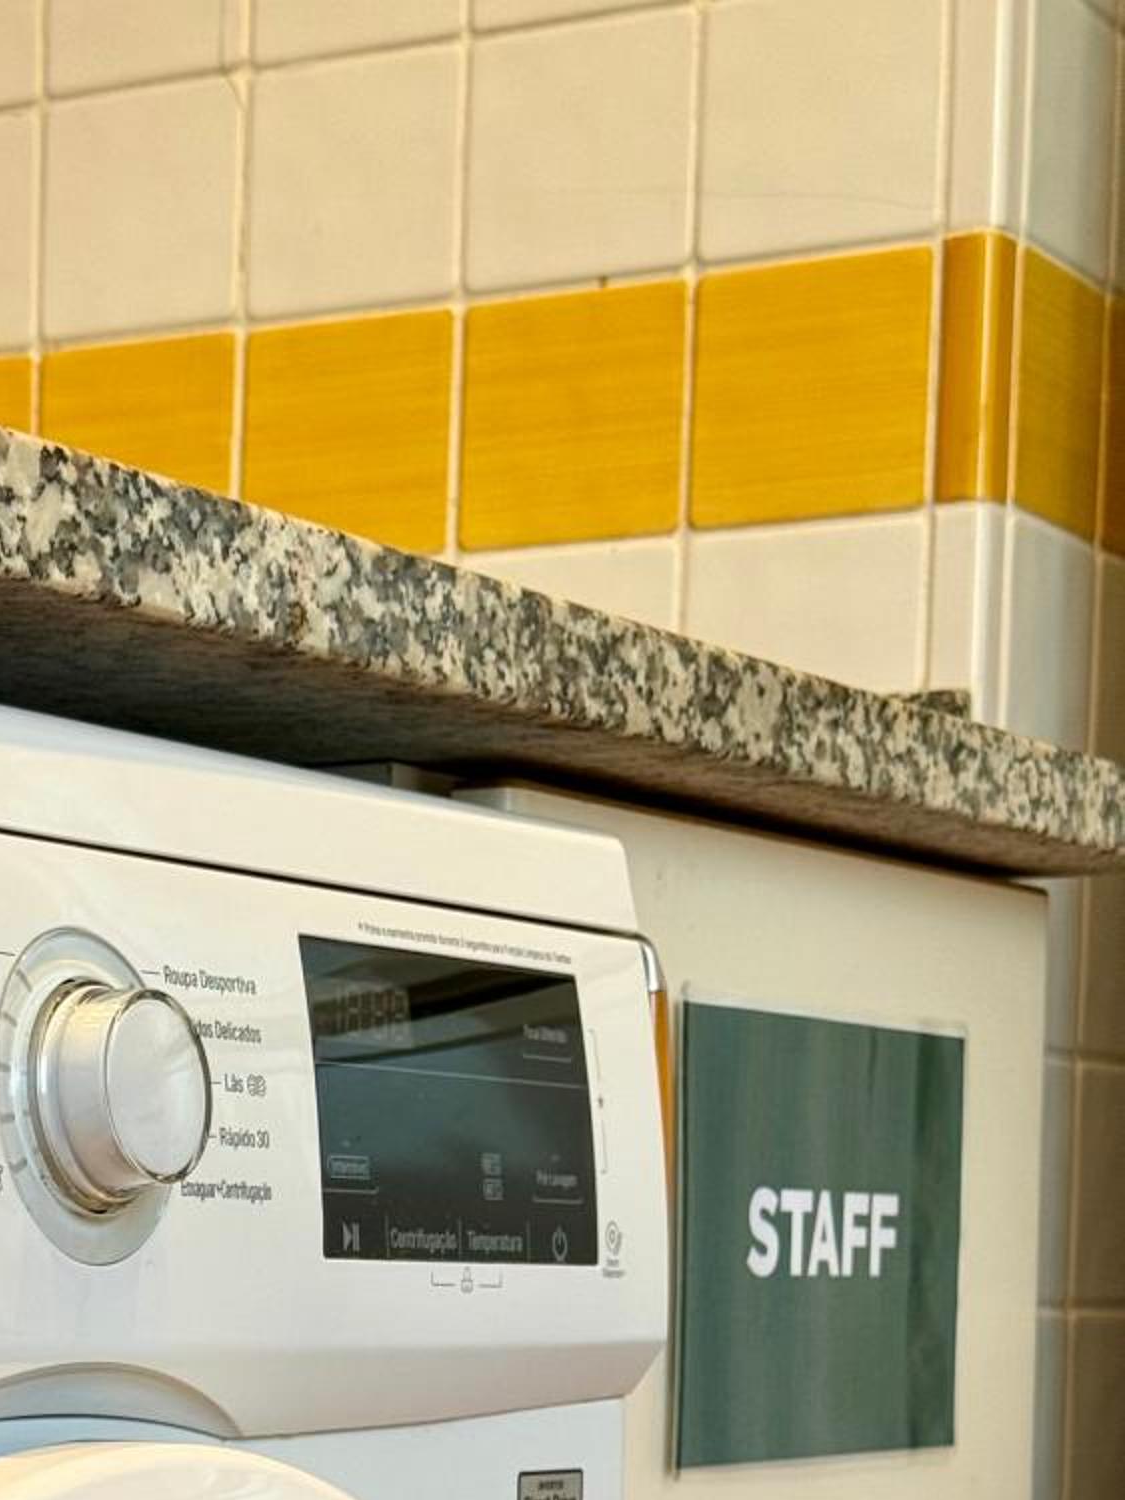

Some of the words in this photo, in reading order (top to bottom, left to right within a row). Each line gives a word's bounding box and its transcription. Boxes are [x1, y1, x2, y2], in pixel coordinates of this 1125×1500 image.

[163, 965, 198, 989] Roupa
[199, 969, 256, 996] Desportiva
[215, 1021, 262, 1043] Delicados
[220, 1127, 255, 1150] Rápido
[256, 1130, 270, 1149] 30
[747, 1187, 899, 1278] STAFF
